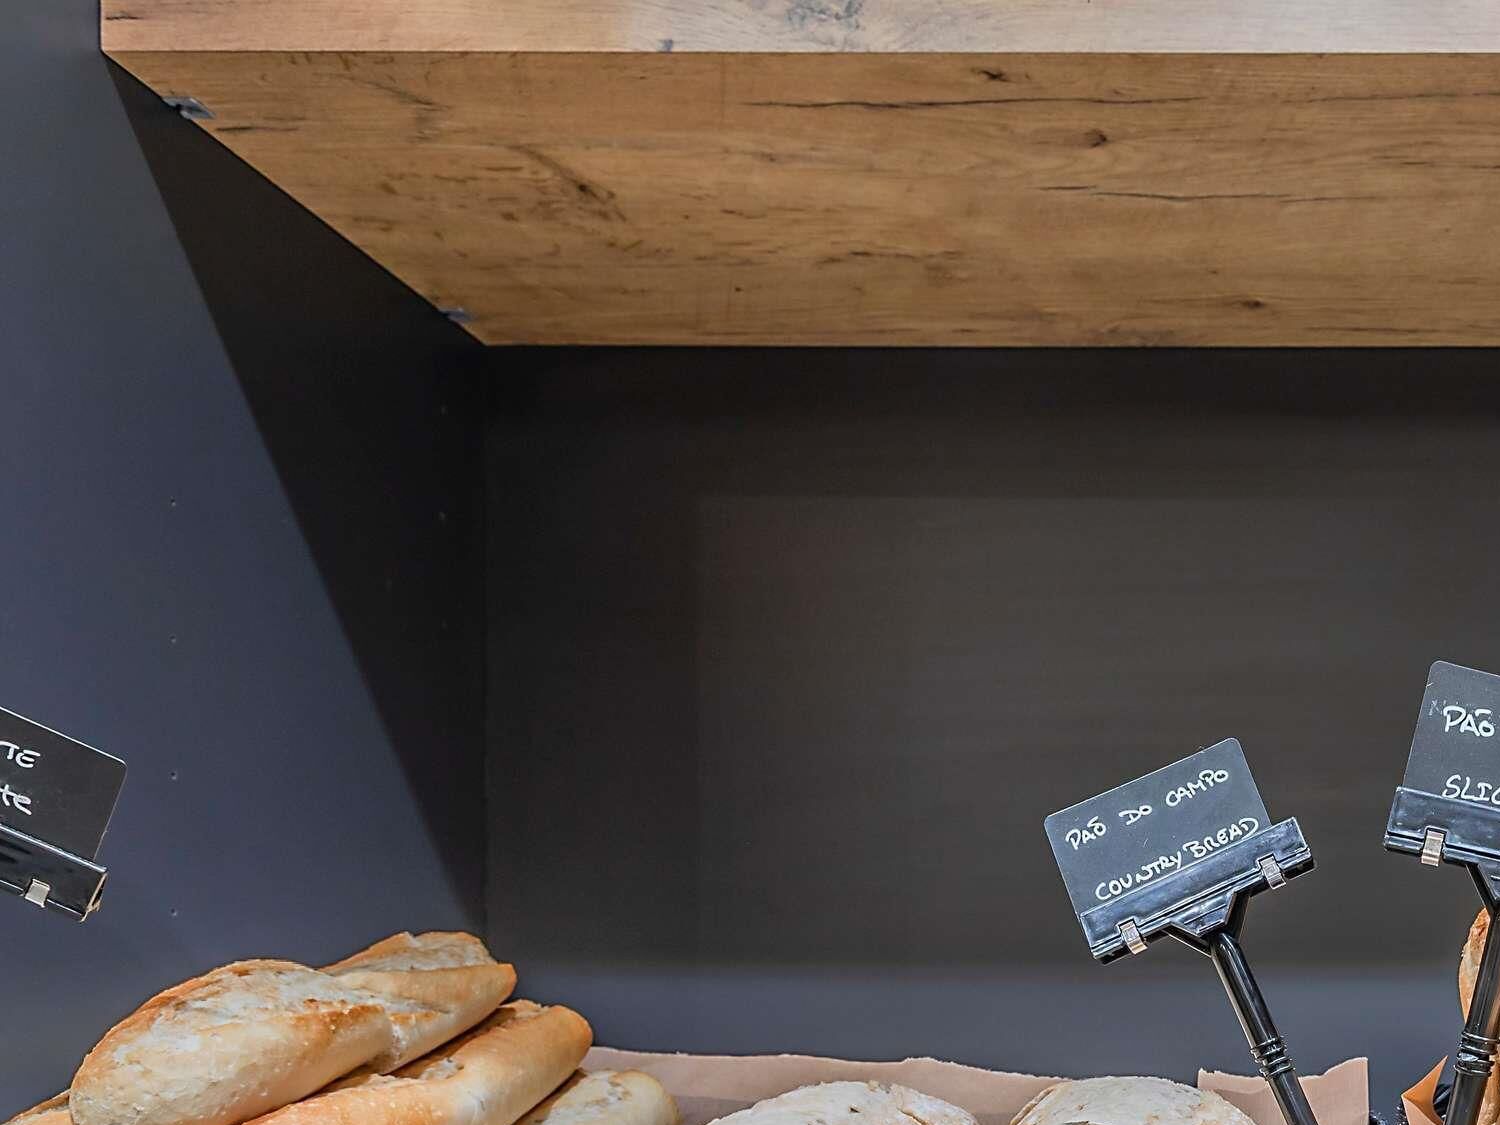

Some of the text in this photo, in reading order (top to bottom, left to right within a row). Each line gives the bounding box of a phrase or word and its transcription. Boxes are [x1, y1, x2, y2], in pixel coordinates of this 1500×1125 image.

[1119, 804, 1153, 826] DO
[1165, 768, 1229, 807] CAMPO
[1182, 817, 1259, 859] BREAD
